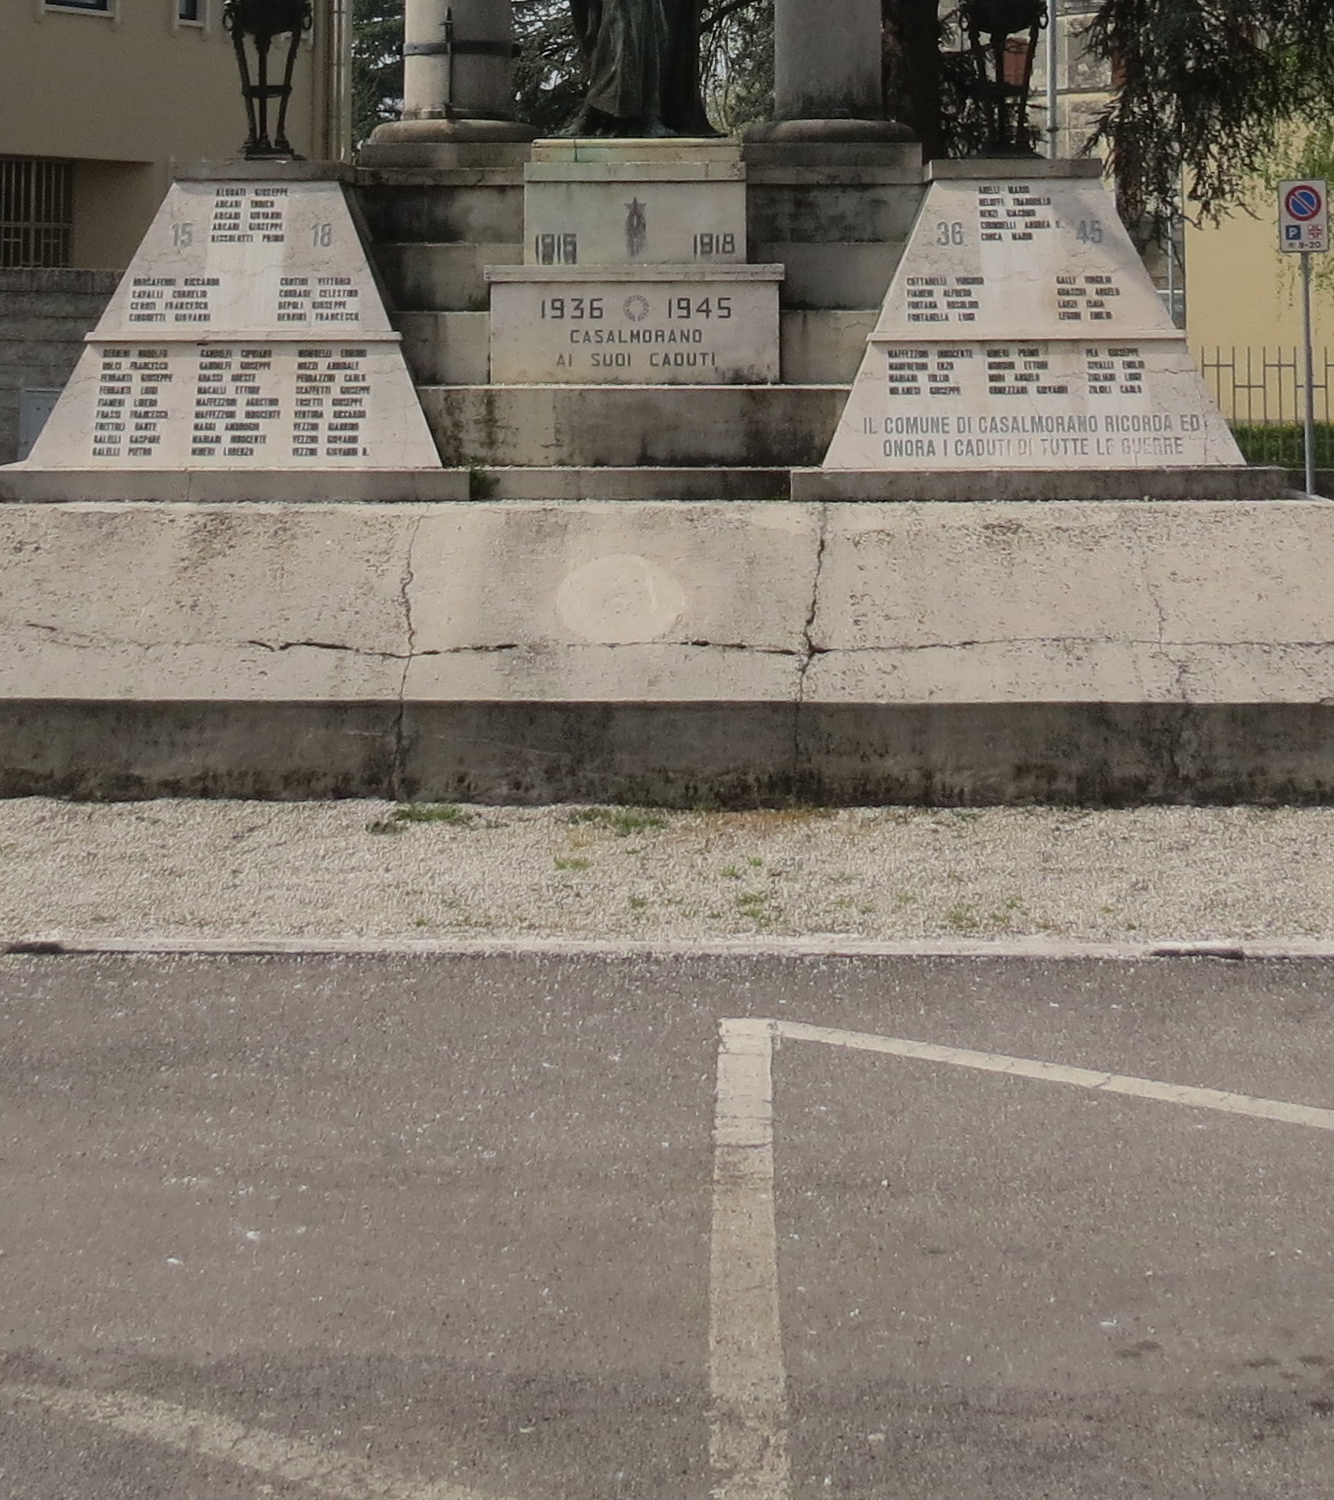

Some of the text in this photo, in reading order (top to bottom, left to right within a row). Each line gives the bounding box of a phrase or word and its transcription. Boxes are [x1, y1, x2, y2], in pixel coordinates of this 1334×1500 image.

[253, 187, 289, 197] GIUSEPPE
[249, 211, 283, 221] GIOVANNI
[248, 222, 283, 232] GIUSEPPE
[1075, 219, 1104, 245] 45
[171, 222, 194, 248] 15
[311, 222, 332, 248] 18
[936, 220, 965, 247] 36
[1289, 227, 1298, 239] P
[692, 232, 736, 255] 1918
[131, 289, 164, 300] CAVALLI
[164, 301, 209, 311] FRANCESCO
[311, 300, 347, 310] GIUSEPPE
[540, 296, 733, 320] 1936 1945
[314, 312, 360, 322] FRANCESCO
[569, 328, 703, 344] CASALMORANO
[556, 351, 716, 367] AI SUOI CADUTI
[128, 361, 169, 371] FRANCESCO
[239, 361, 272, 371] GIUSEPPE
[140, 373, 174, 383] GIUSEPPE
[339, 385, 371, 396] GIUSEPPE
[928, 385, 961, 396] GIUSEPPE
[331, 397, 363, 407] GIUSEPPE
[129, 409, 169, 420] FRANCESCO
[883, 416, 950, 435] COMUNE
[956, 415, 972, 434] DI
[978, 414, 1098, 434] CASALMORANO
[1104, 414, 1172, 433] RICORDA
[1180, 414, 1200, 432] ED
[882, 438, 936, 458] ONORA
[943, 438, 949, 457] I
[953, 438, 1013, 457] CADUTI
[1018, 438, 1033, 456] DI
[1040, 437, 1089, 456] TUTTE
[1121, 436, 1184, 456] GUERRE
